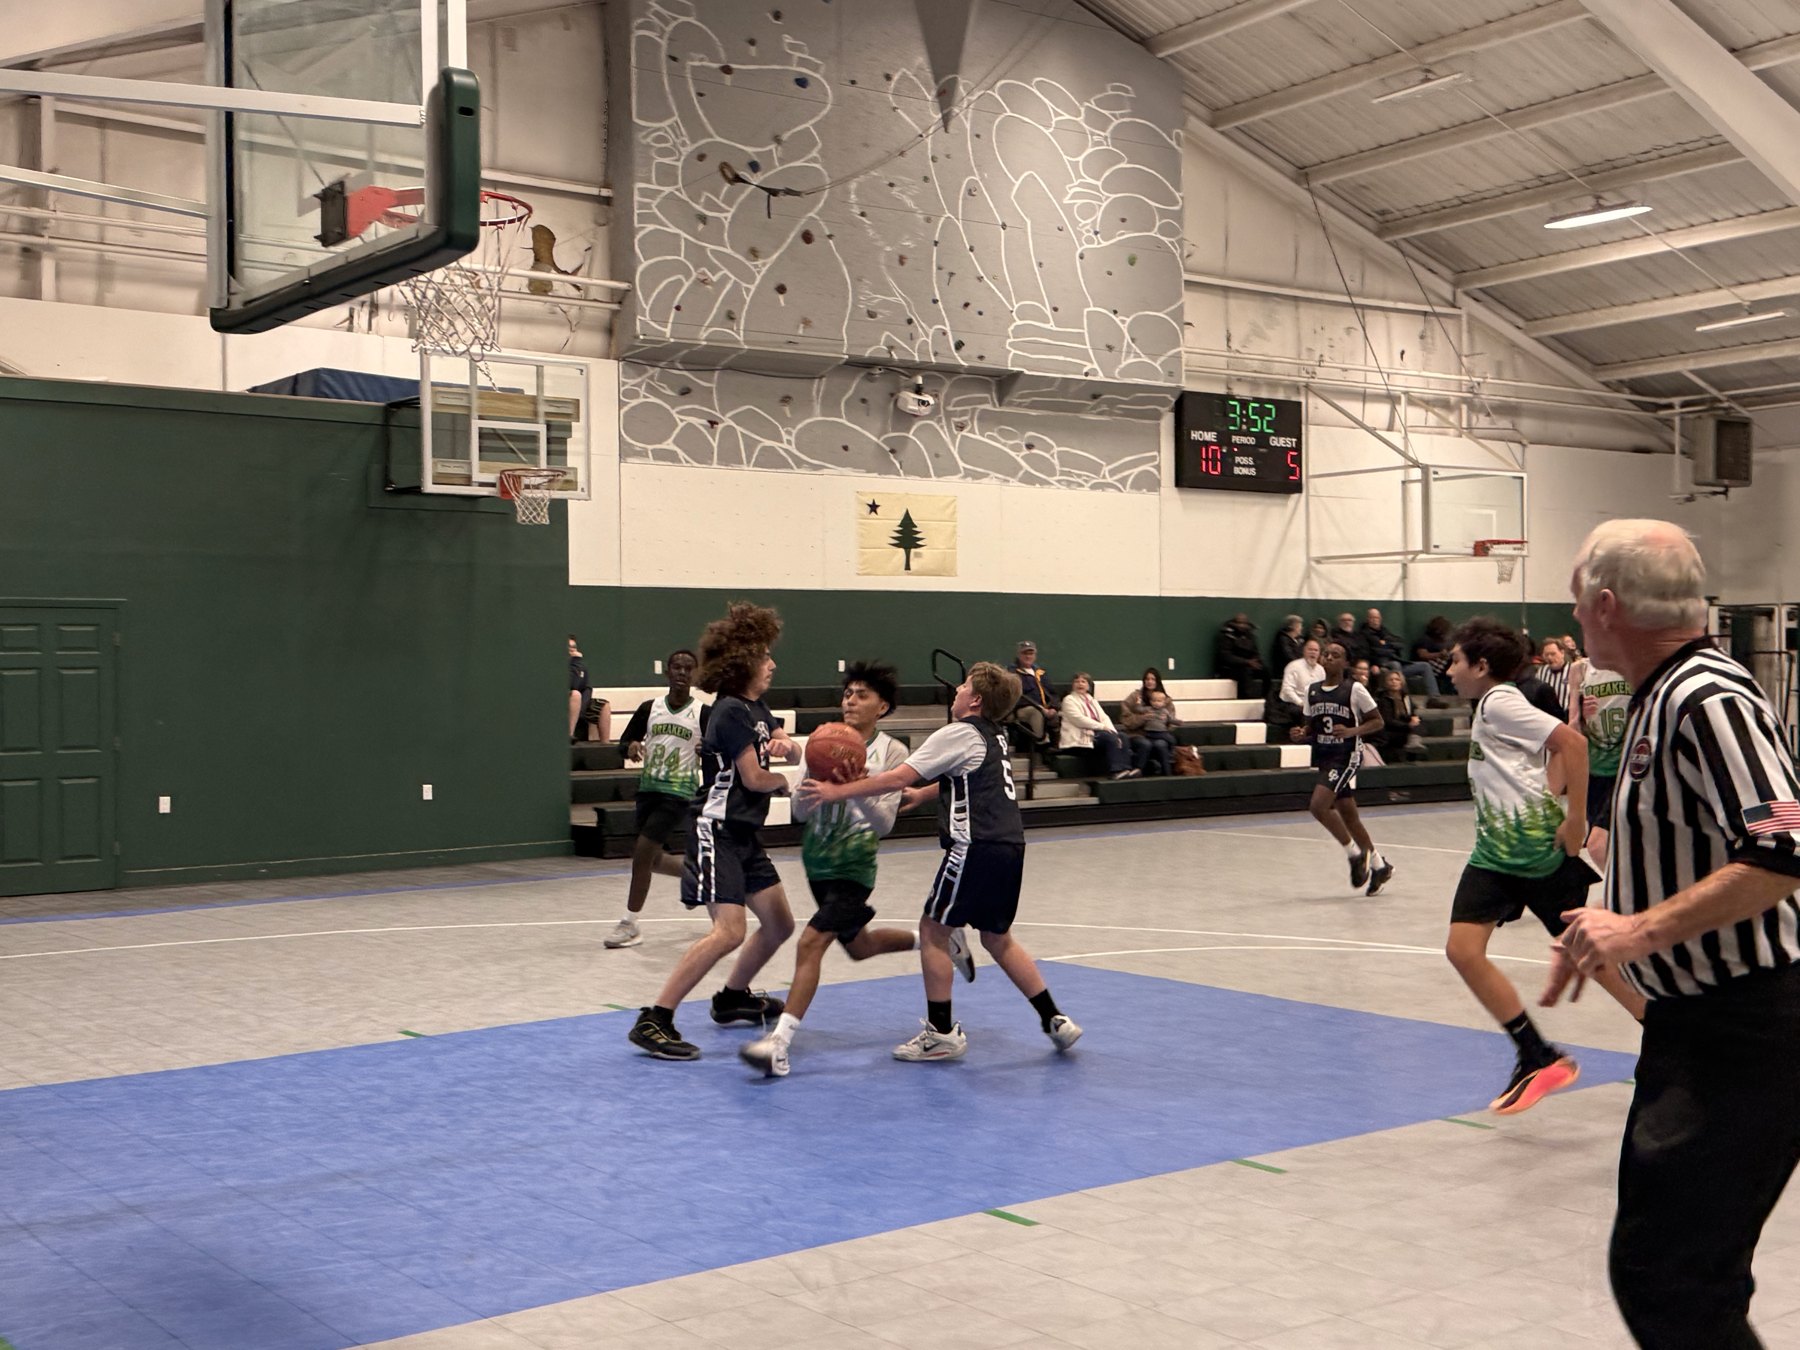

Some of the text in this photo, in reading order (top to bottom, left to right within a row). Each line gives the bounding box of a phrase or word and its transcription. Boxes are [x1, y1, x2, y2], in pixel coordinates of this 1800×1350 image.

[1228, 400, 1276, 433] 3:52
[1190, 431, 1217, 442] HOME
[1232, 436, 1256, 445] PERIOD
[1269, 437, 1297, 448] GUEST
[1201, 445, 1221, 476] 10
[1233, 466, 1257, 476] BONUS
[1286, 451, 1300, 480] 5
[651, 723, 693, 741] BREAKERS
[1323, 716, 1333, 734] 3
[1599, 707, 1626, 740] 16
[652, 743, 681, 769] 24
[1001, 759, 1016, 801] 5
